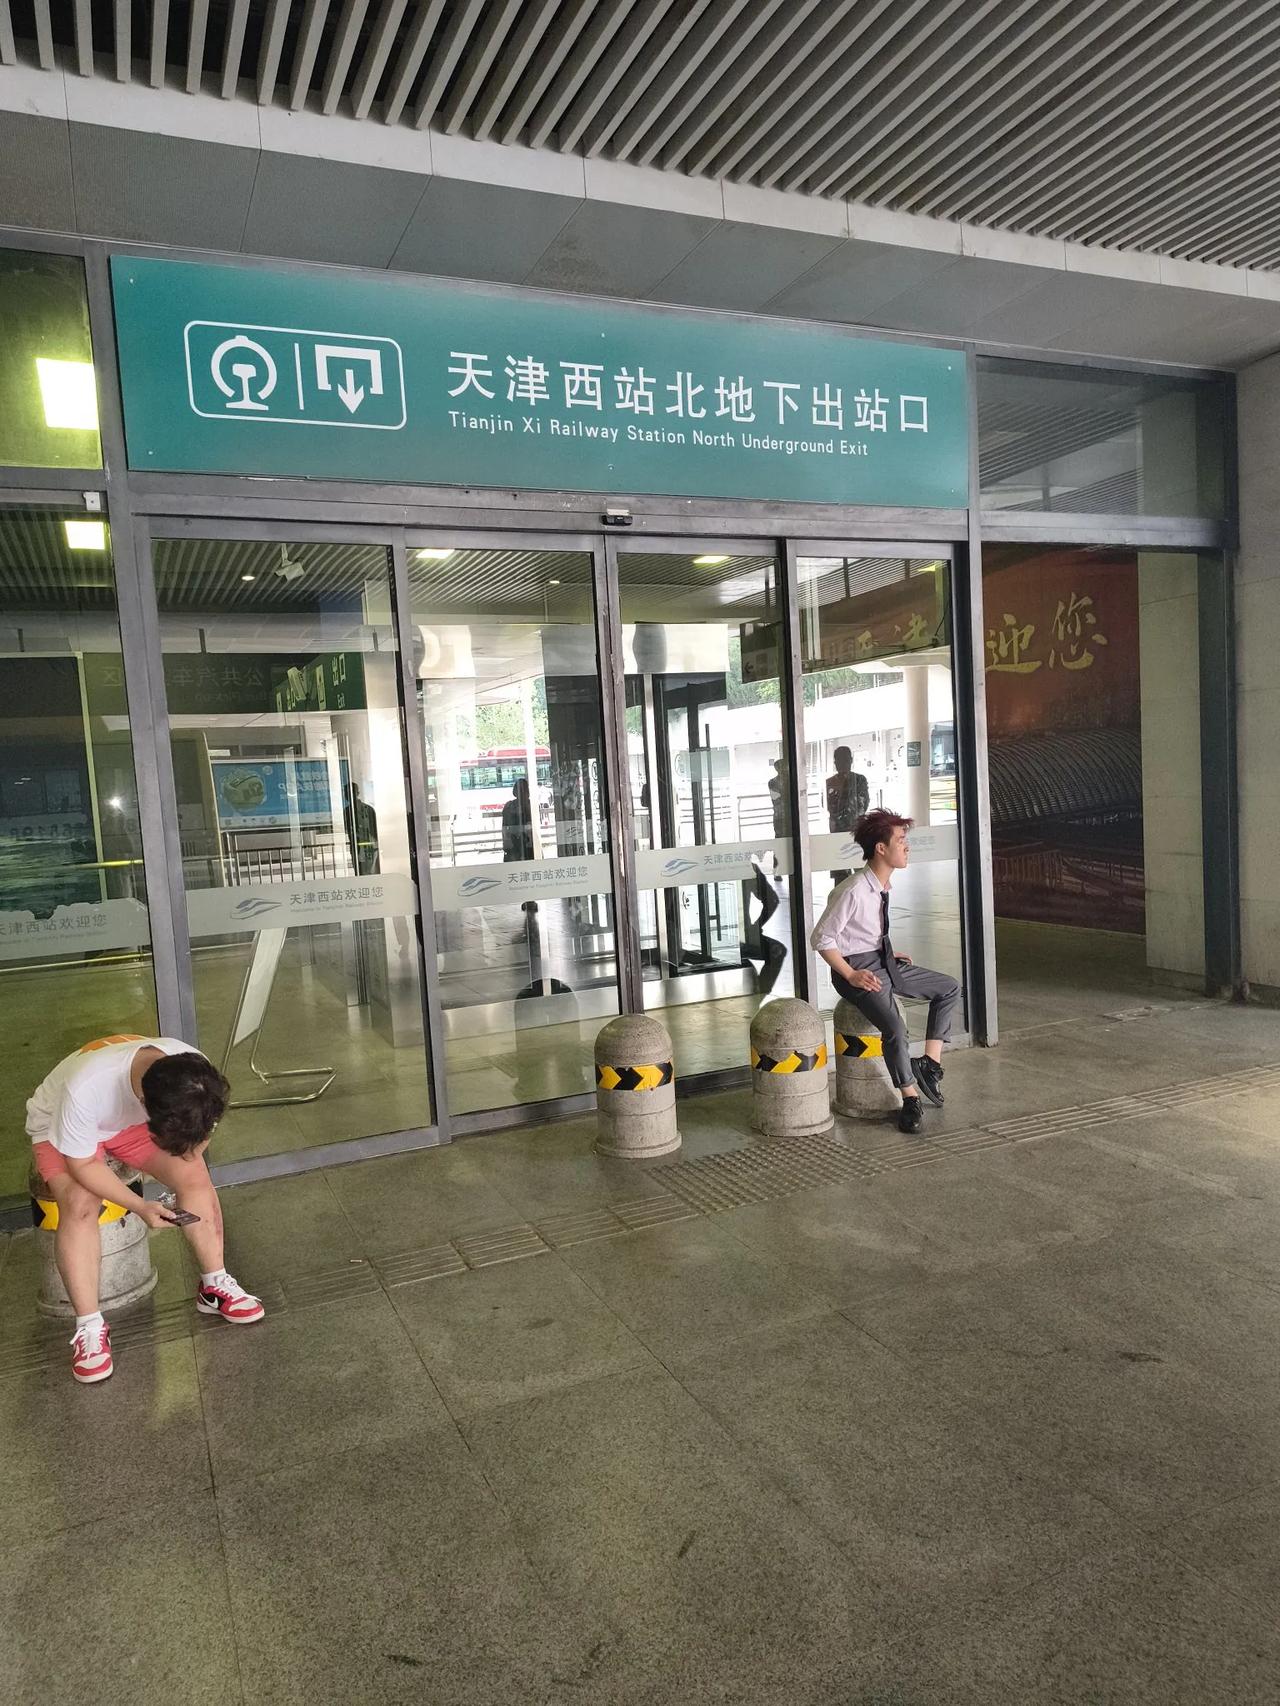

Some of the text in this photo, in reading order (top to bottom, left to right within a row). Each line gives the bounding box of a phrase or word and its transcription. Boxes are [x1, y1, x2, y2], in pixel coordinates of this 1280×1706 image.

[447, 351, 928, 433] 天津西站北地下出站口
[448, 411, 868, 456] Tianjin Xi Railway Station North Underground Exit
[983, 591, 1108, 674] 迎您
[289, 886, 384, 905] 天津西站欢迎您
[508, 865, 588, 884] 天津西站欢迎您
